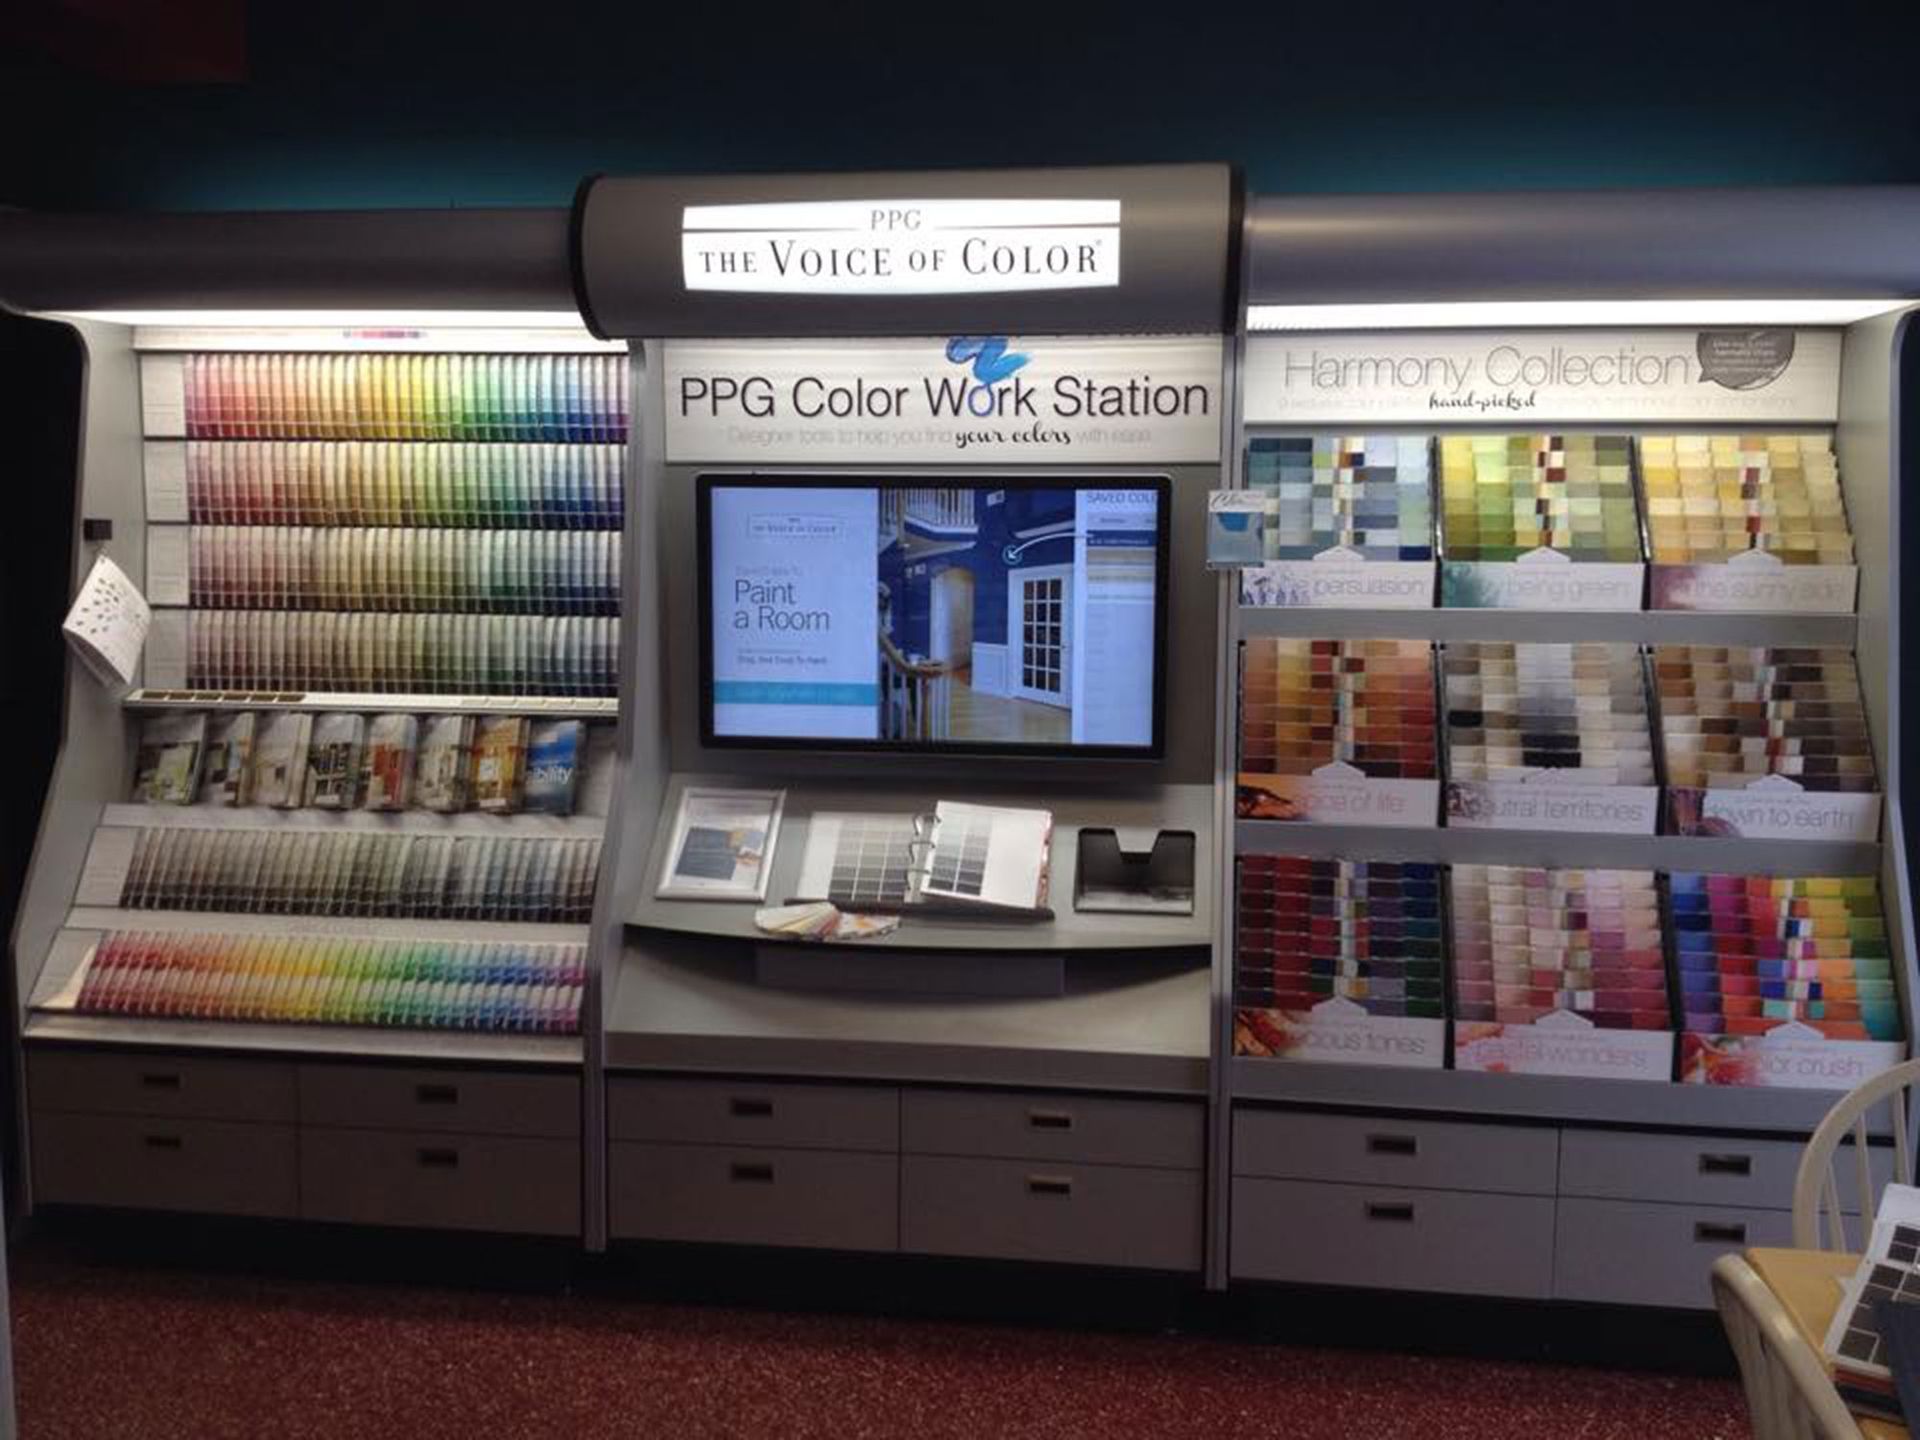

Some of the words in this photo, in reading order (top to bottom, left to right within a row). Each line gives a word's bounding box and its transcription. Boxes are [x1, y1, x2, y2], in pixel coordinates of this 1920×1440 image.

[871, 209, 921, 230] PPG
[699, 251, 757, 273] THE
[768, 239, 892, 277] VOICE
[909, 249, 945, 272] OF
[1285, 350, 1472, 394] Harmony
[1485, 346, 1689, 386] Collection
[682, 377, 774, 417] PPG
[793, 377, 909, 417] Color
[924, 376, 1037, 417] Work
[1053, 375, 1208, 417] Station
[1429, 390, 1536, 413] hand-picked
[955, 431, 1004, 448] your
[1011, 422, 1071, 444] colors
[735, 579, 797, 605] Paint
[735, 610, 749, 630] a
[758, 605, 829, 631] Room
[1794, 807, 1856, 829] earth
